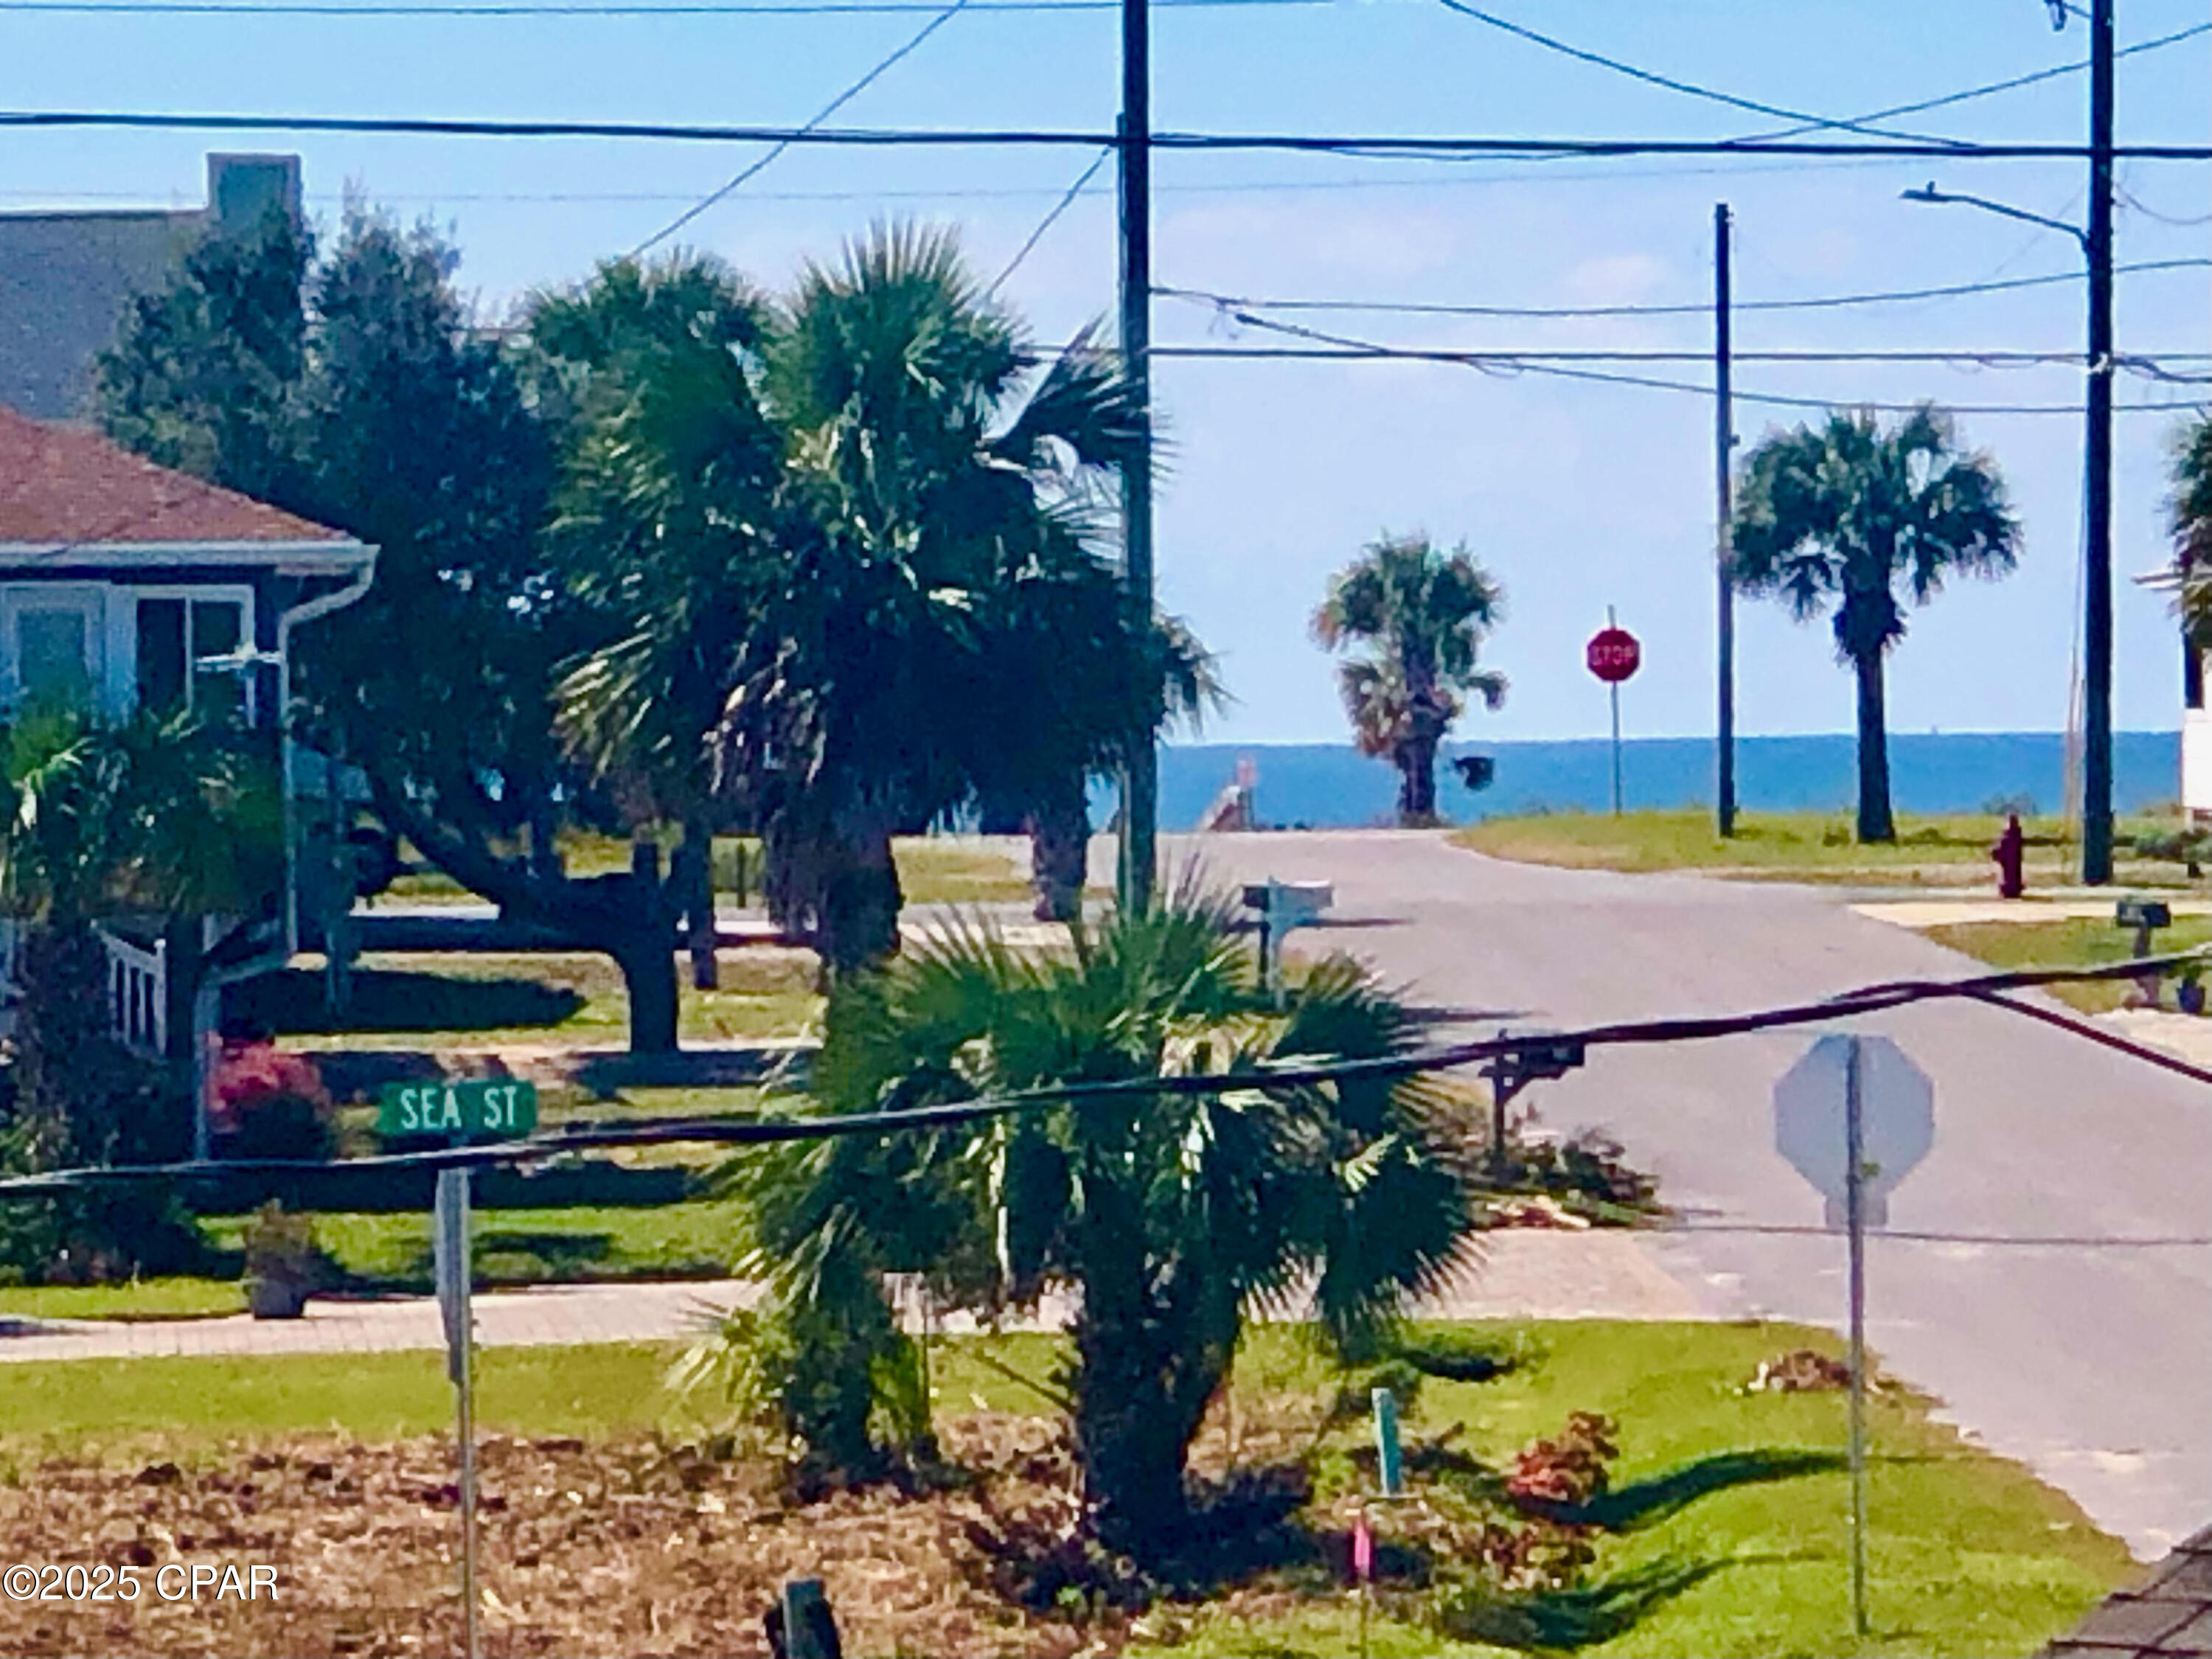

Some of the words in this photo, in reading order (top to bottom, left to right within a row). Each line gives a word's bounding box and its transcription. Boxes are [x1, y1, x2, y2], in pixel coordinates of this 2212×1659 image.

[1591, 645, 1635, 665] STOP
[400, 1088, 462, 1130] SEA
[484, 1085, 518, 1129] ST
